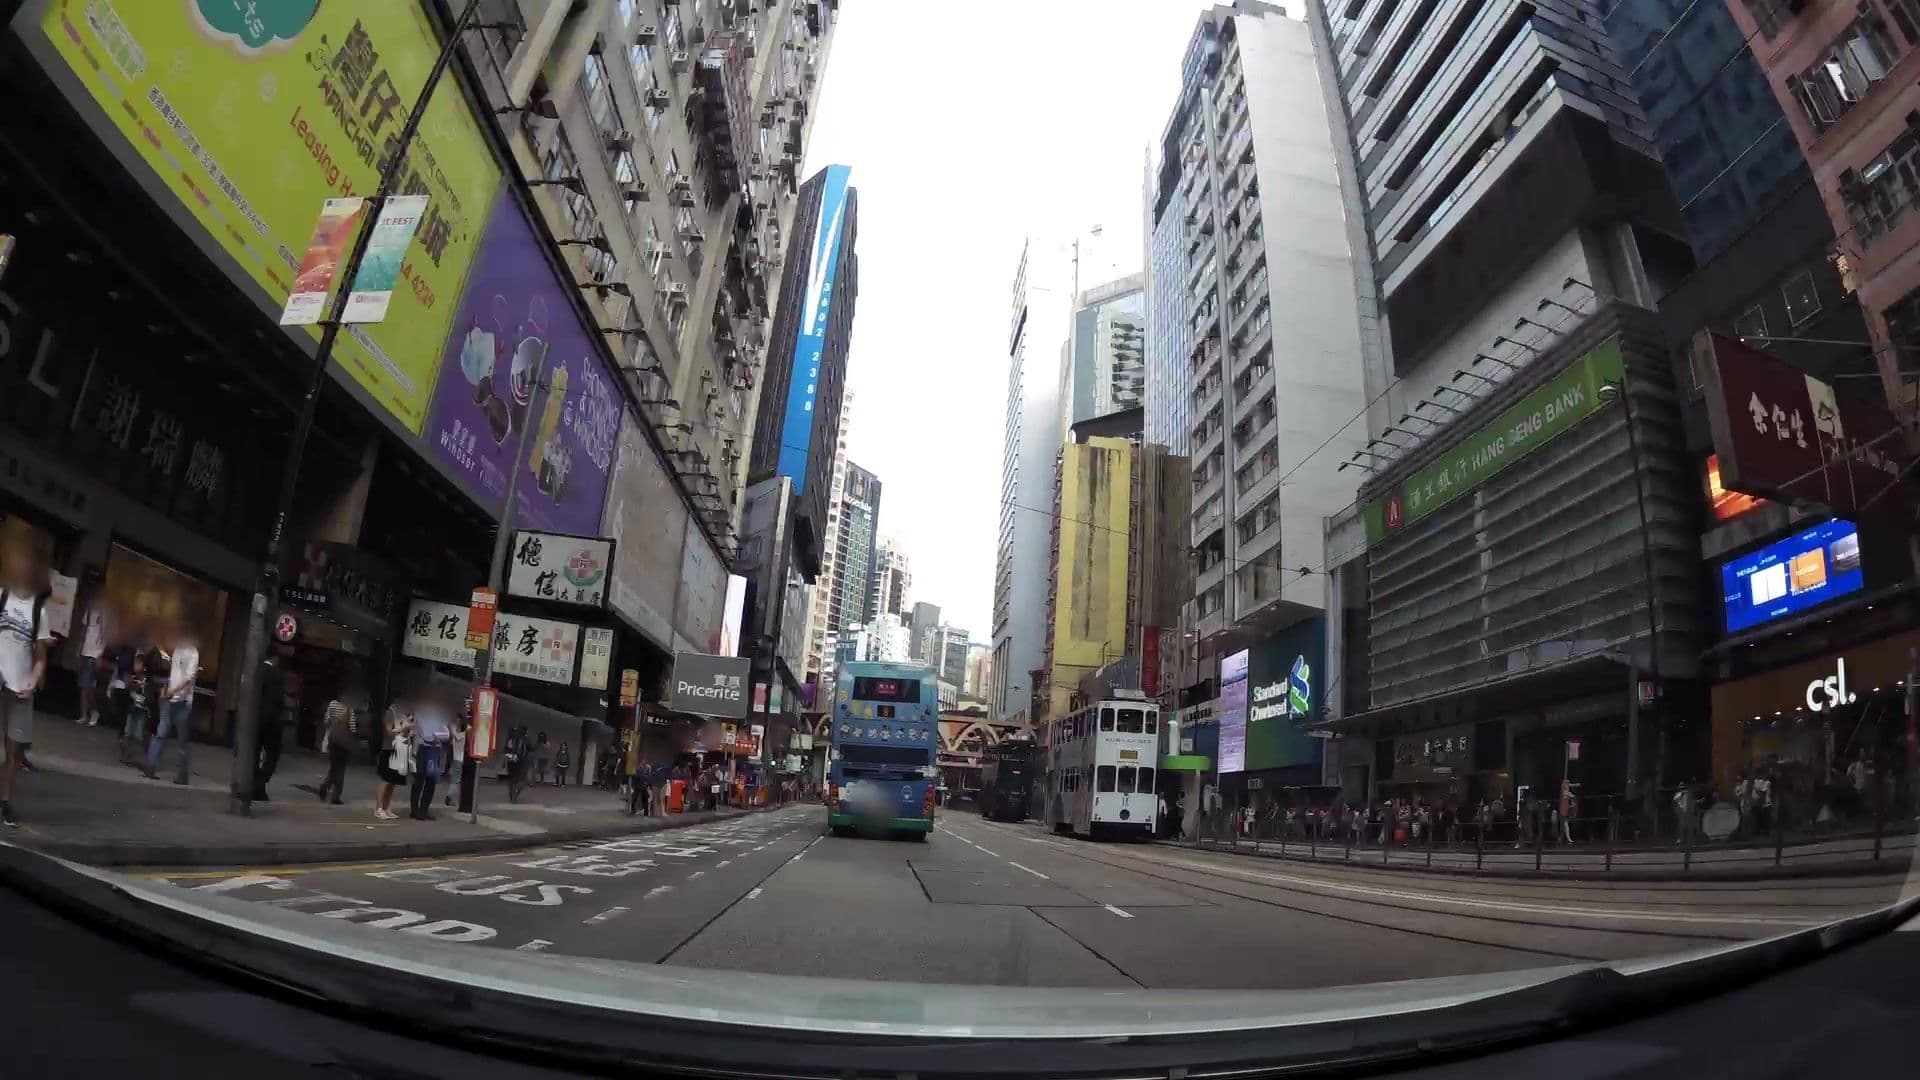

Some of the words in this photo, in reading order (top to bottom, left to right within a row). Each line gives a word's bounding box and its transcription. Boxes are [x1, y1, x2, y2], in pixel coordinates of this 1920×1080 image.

[289, 105, 340, 187] Leasing
[1471, 436, 1505, 472] HANG
[1545, 382, 1586, 424] BANK
[677, 681, 741, 702] Pricerite
